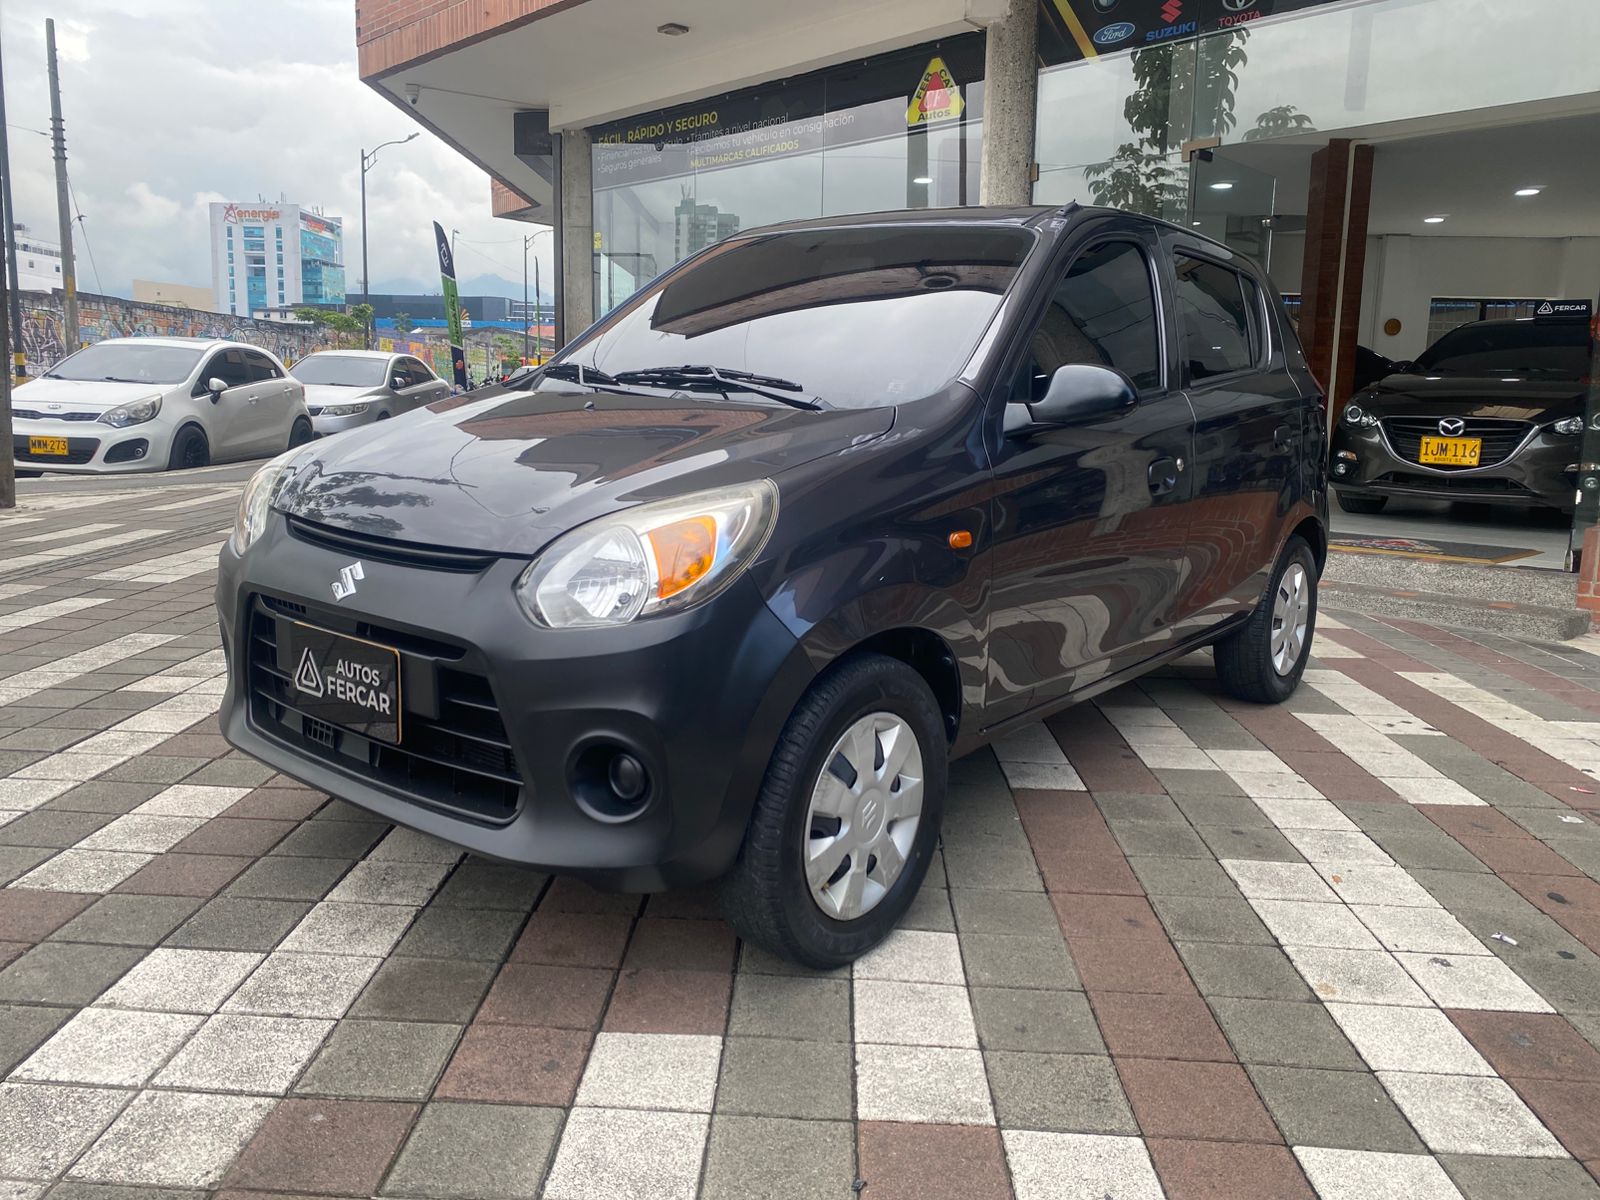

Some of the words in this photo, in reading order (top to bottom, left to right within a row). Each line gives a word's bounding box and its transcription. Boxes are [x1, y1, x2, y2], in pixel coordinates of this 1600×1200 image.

[1218, 10, 1261, 27] TOYOTA
[1101, 25, 1128, 41] Ford
[1146, 21, 1197, 41] SUZUKI
[915, 72, 932, 99] FER
[731, 123, 750, 134] nivel
[752, 112, 789, 130] nacional
[917, 109, 951, 121] Autos
[628, 124, 664, 143] RÁPIDO
[667, 120, 674, 133] Y
[675, 111, 718, 132] SEGURO
[779, 127, 791, 138] en
[691, 151, 744, 169] MULTIMARCAS
[745, 139, 799, 158] CALIFICADOS
[336, 658, 381, 687] AUTOS
[327, 675, 391, 715] FERCAR
